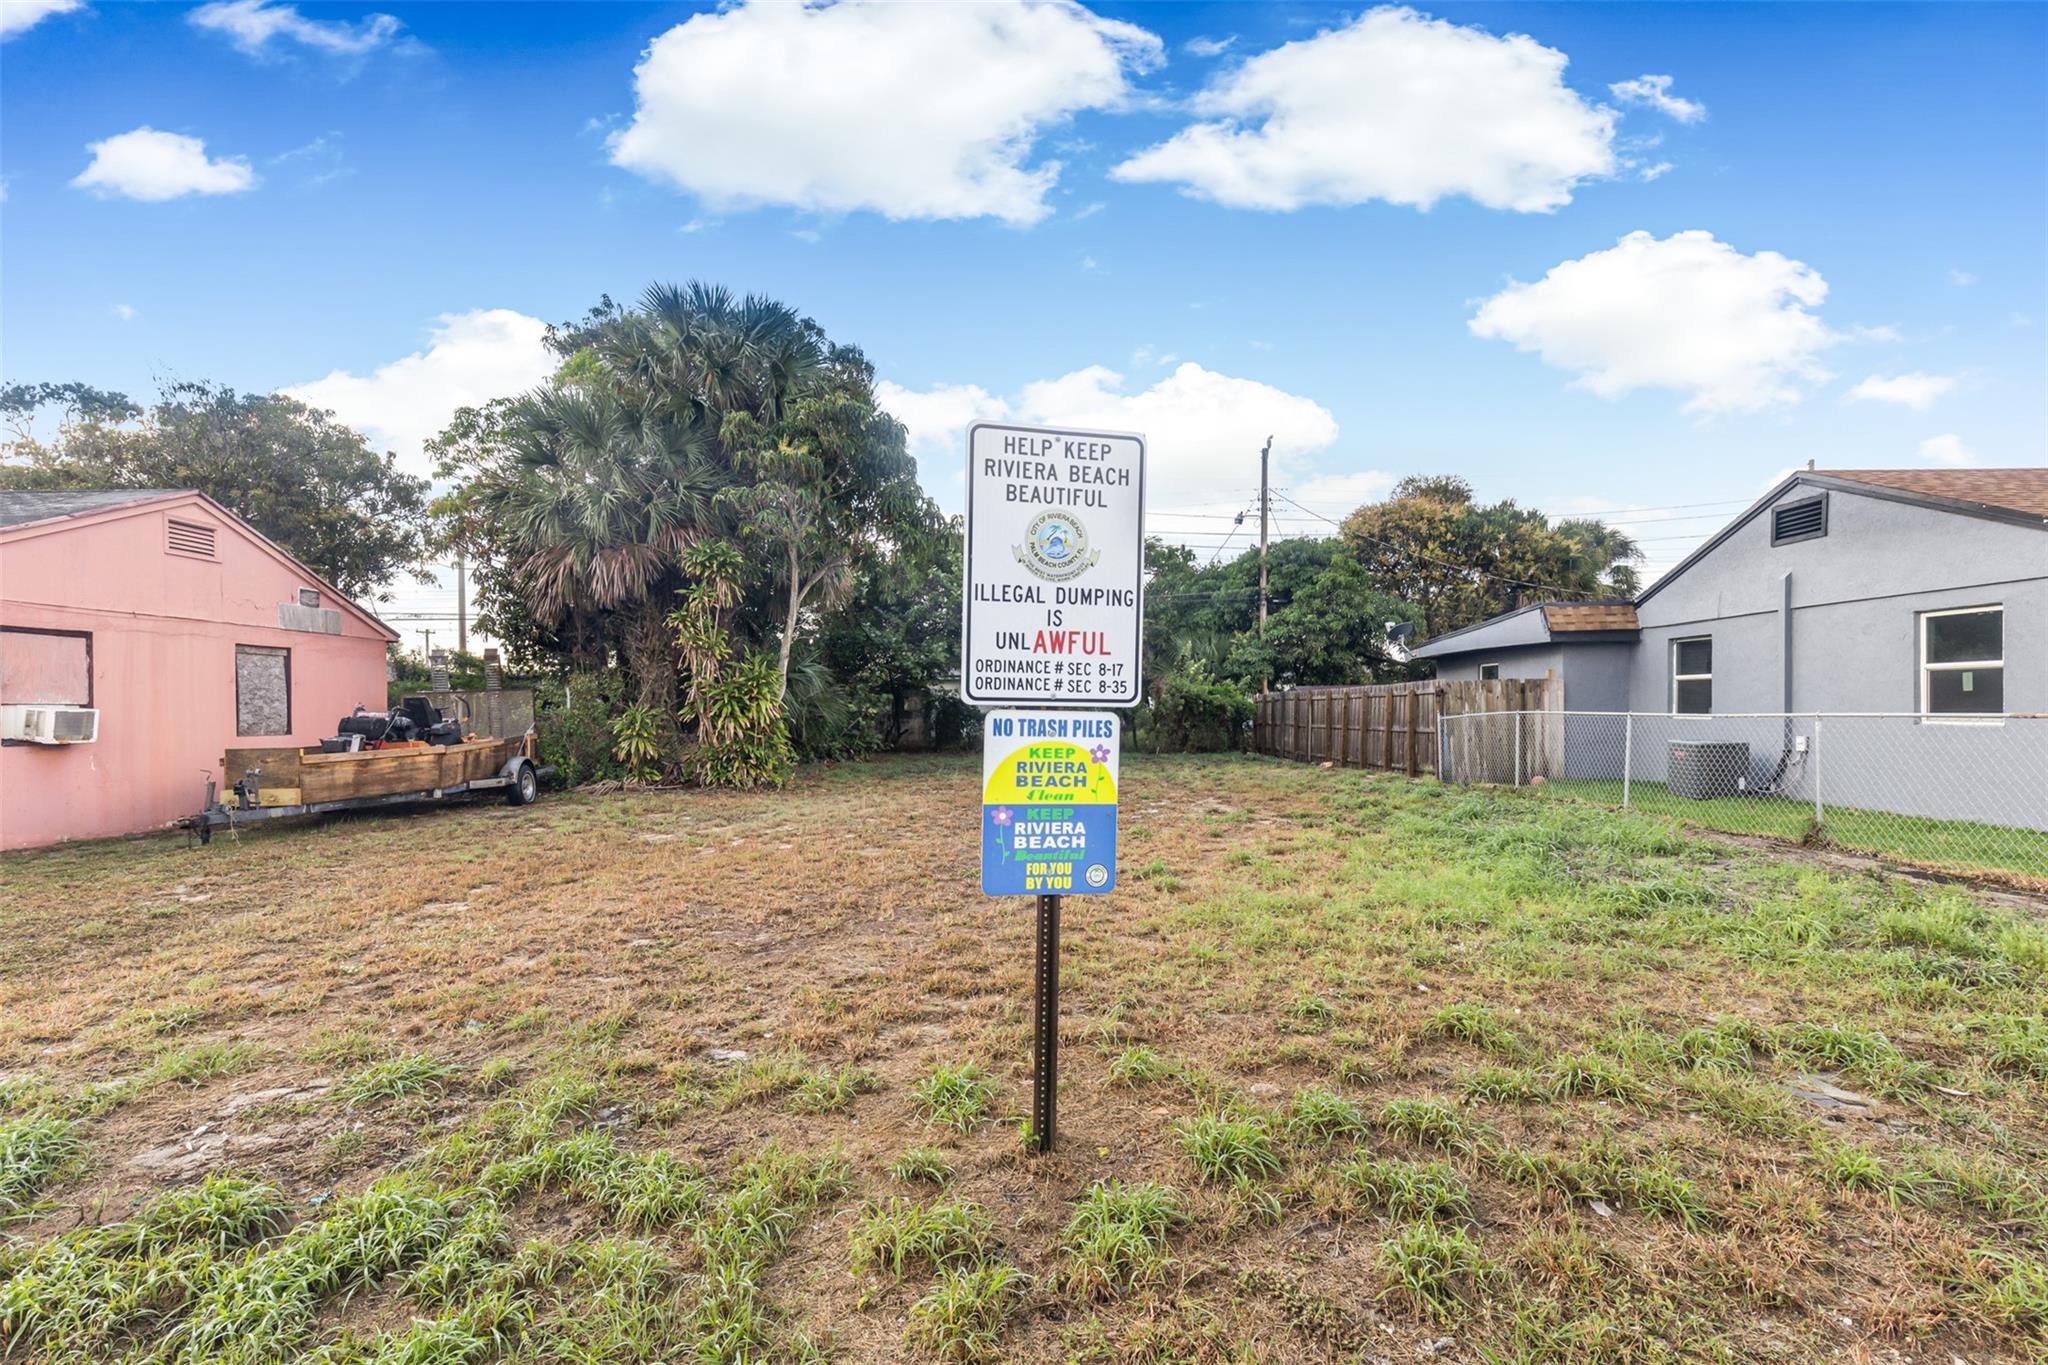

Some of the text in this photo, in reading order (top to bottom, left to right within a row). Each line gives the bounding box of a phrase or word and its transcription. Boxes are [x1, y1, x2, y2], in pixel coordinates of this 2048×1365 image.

[1004, 436, 1112, 461] HELP KEEP
[984, 459, 1130, 486] RIVIERA BEACH
[1006, 484, 1108, 508] BEAUTIFUL
[974, 583, 1134, 607] ILLEGAL DUMPING
[1047, 609, 1063, 627] IS
[995, 630, 1112, 656] UNLAWFUL
[975, 659, 1123, 677] ORDINANCE # SEC 8-17
[975, 677, 1127, 694] ORDINANCE # SEC 8-35
[993, 718, 1113, 738] NO TRASH PILES
[1029, 747, 1076, 759] KEEP
[1016, 761, 1087, 773] RIVIERA
[1016, 775, 1087, 787] BEACH
[1026, 789, 1075, 801] Clean
[1026, 808, 1075, 820] KEEP
[1014, 822, 1086, 834] RIVIERA
[1014, 836, 1086, 848] BEACH
[1014, 850, 1086, 861] Beautiful
[1025, 862, 1072, 875] FOR YOU
[1025, 877, 1072, 890] BY YOU
